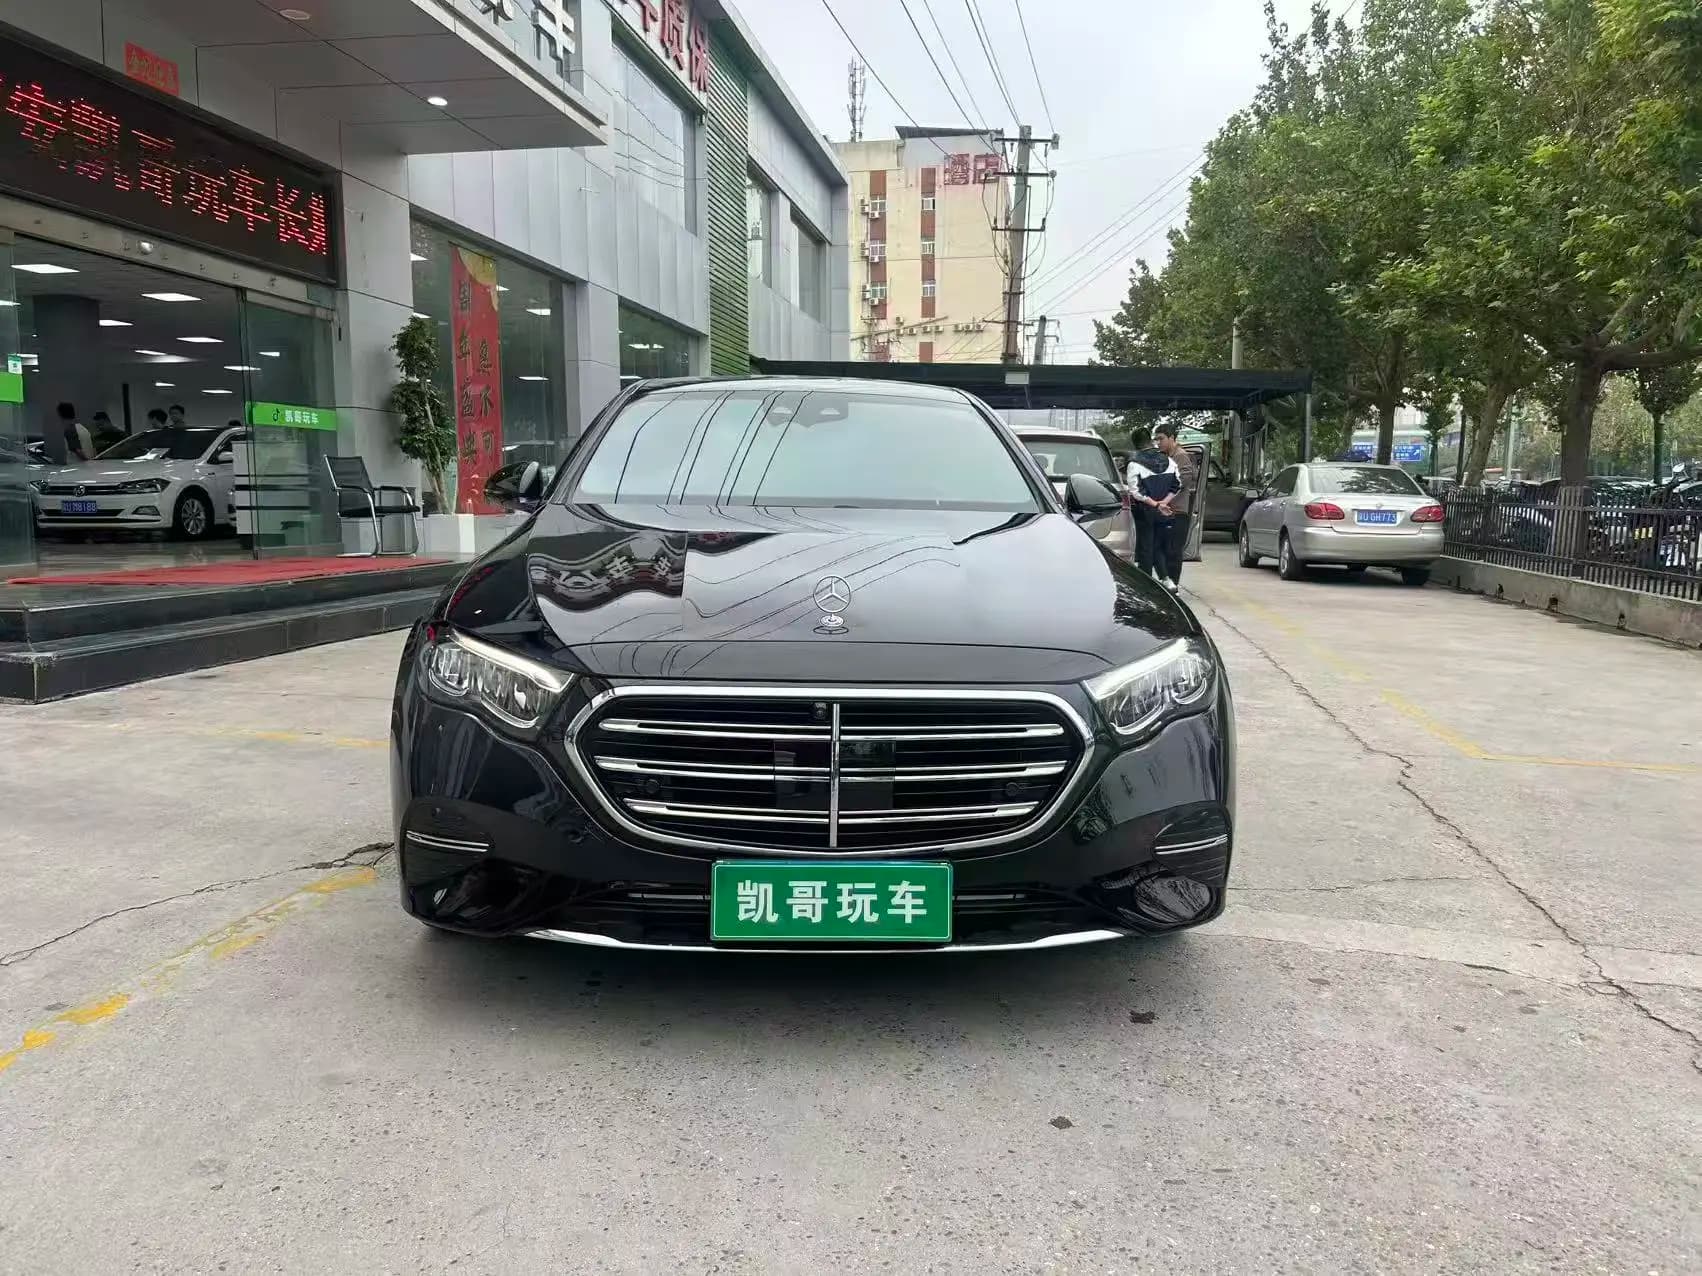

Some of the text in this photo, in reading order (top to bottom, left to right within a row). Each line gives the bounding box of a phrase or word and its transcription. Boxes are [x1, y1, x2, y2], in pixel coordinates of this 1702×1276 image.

[944, 153, 1000, 186] 酒店
[284, 409, 319, 425] 凯哥玩车
[737, 880, 928, 924] 凯哥玩车
